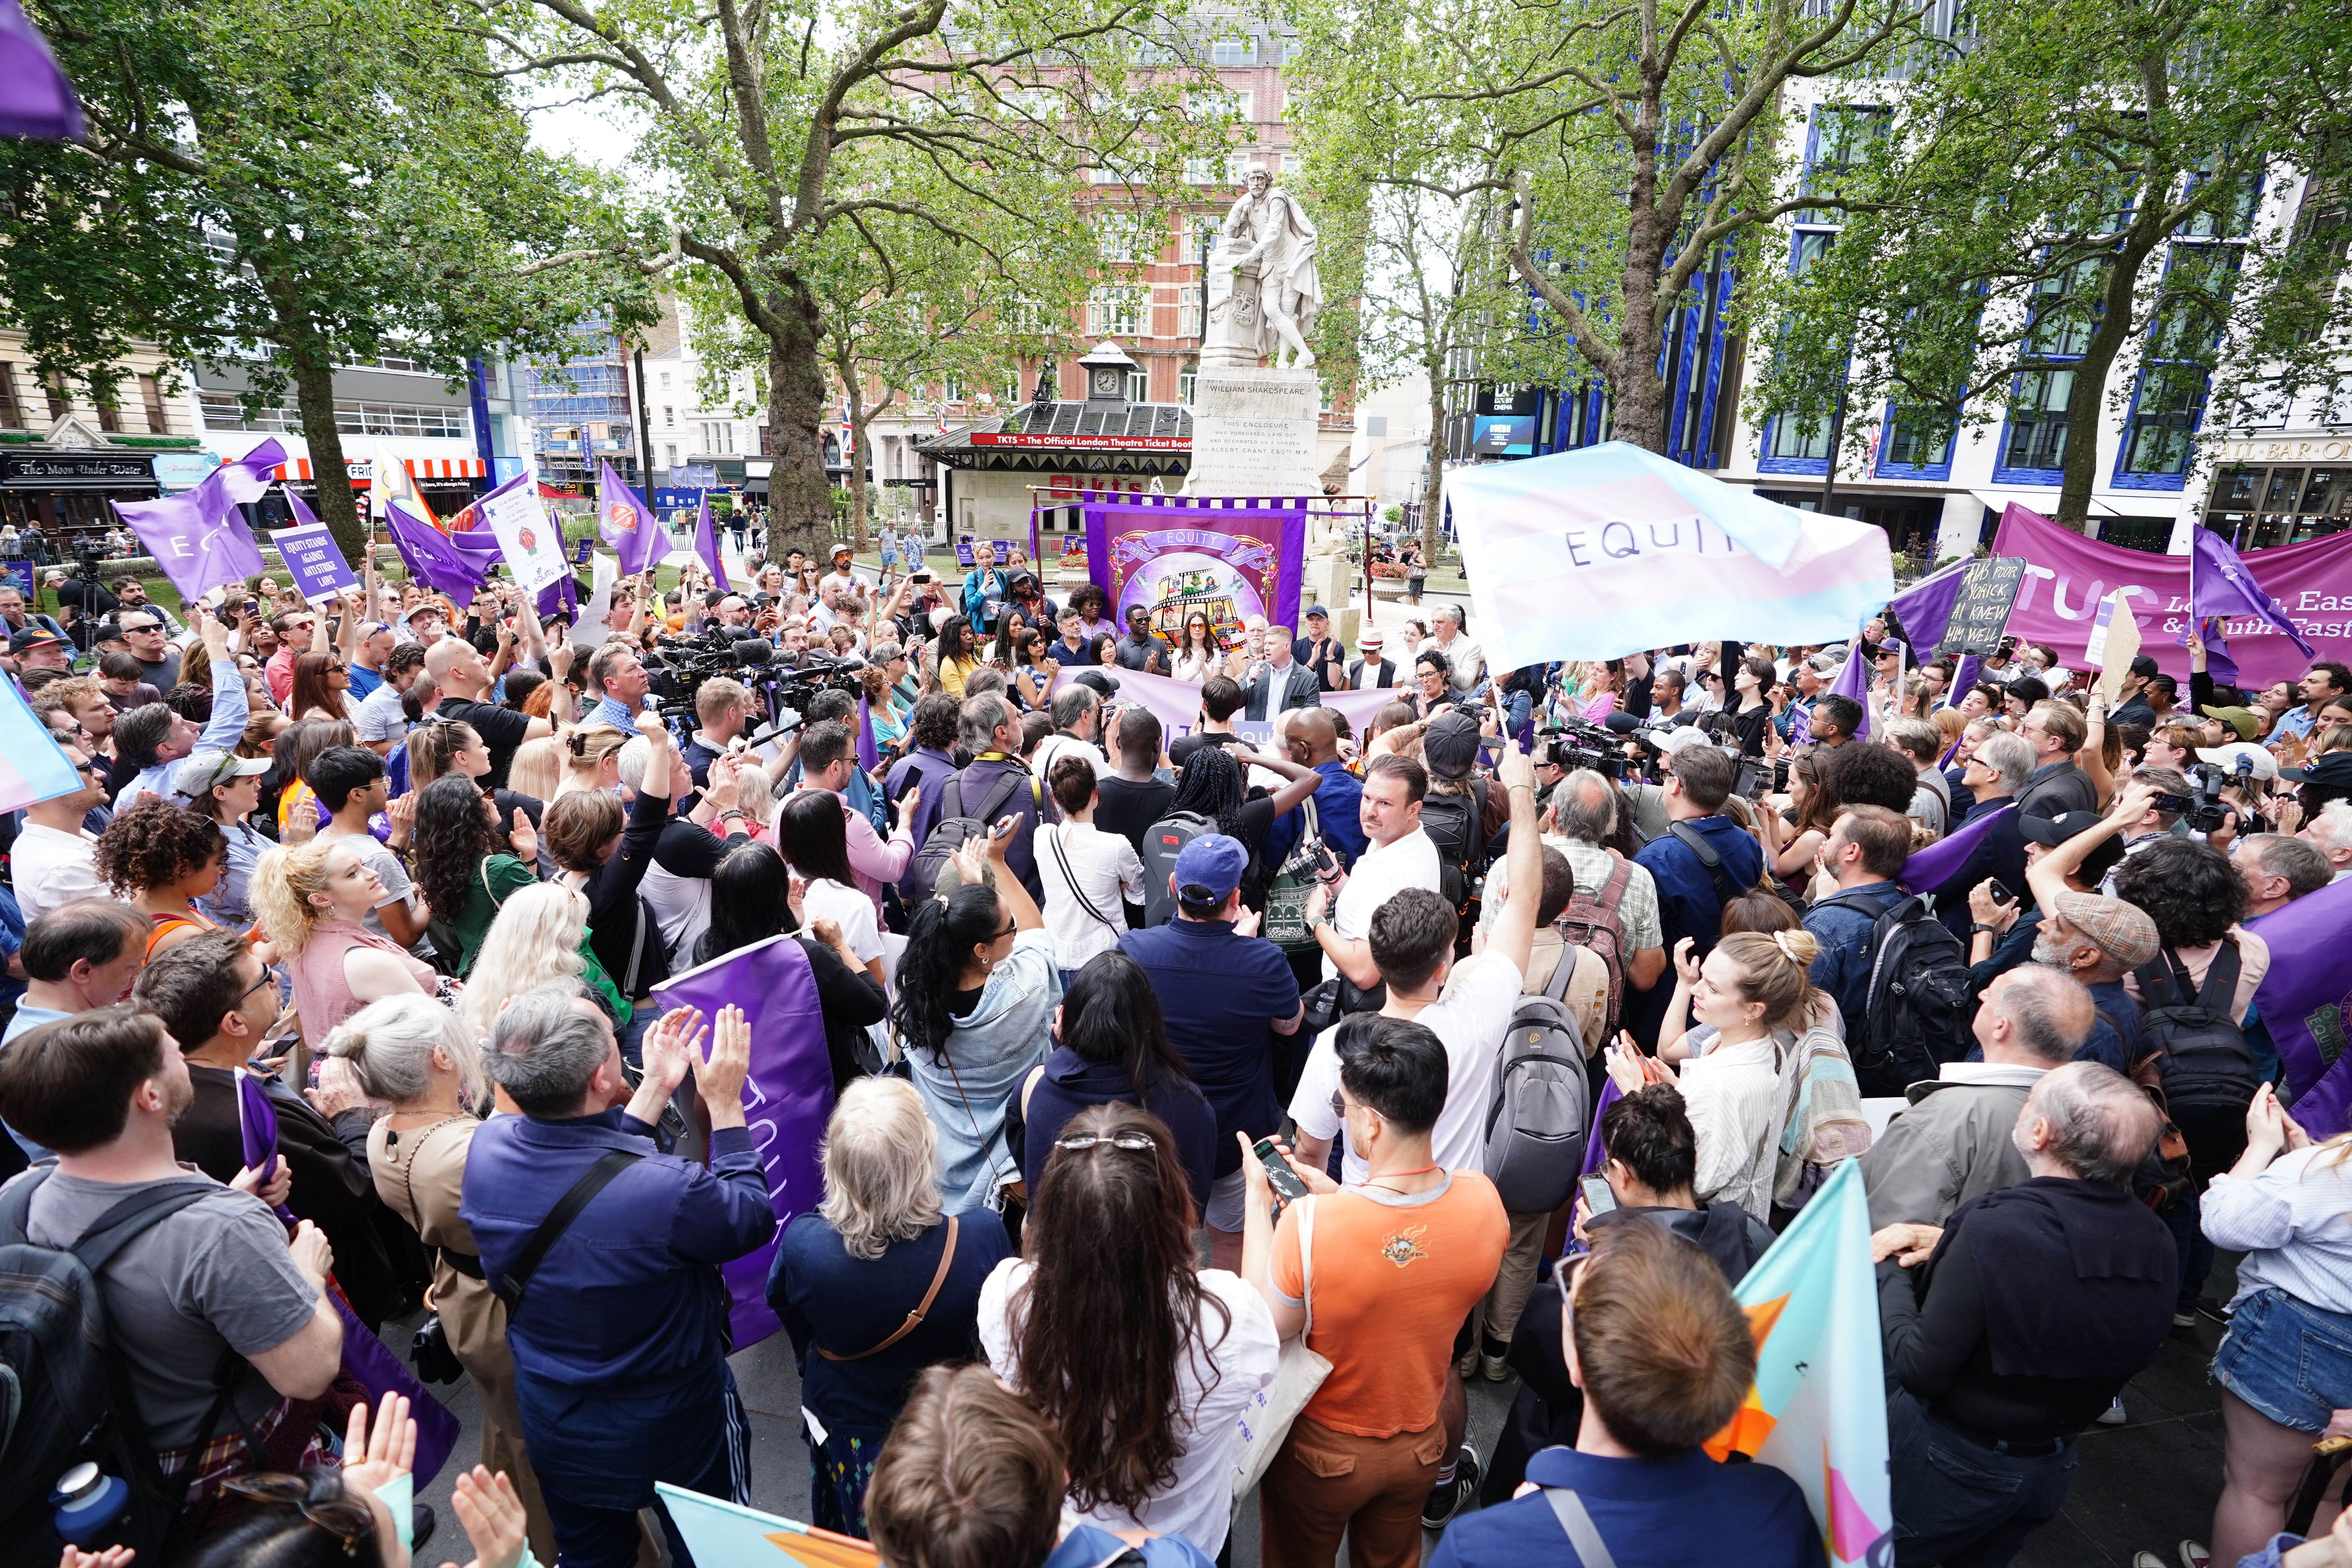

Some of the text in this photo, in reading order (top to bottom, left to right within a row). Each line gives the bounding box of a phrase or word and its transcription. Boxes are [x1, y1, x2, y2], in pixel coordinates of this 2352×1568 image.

[1248, 387, 1305, 395] SHAKESPEARE
[1490, 424, 1511, 433] ODEON
[1027, 436, 1042, 445] The
[1044, 437, 1075, 445] Official
[1077, 437, 1109, 446] London
[1111, 438, 1143, 447] Theatre
[1144, 439, 1170, 448] Ticket
[2215, 442, 2256, 459] ALL
[2266, 442, 2311, 459] BAR
[20, 460, 142, 475] The Moon Under Water
[1074, 476, 1143, 500] tkts
[284, 536, 328, 554] EQUITY STANDS
[1167, 532, 1218, 545] EQUITY
[300, 550, 326, 564] AGAINST
[1129, 545, 1144, 558] 1930
[317, 574, 336, 587] LAWS
[533, 568, 555, 584] equity
[1962, 563, 2018, 585] ALAS POOR
[1968, 583, 2009, 602] YORICK,
[1969, 604, 2011, 621] KNEW
[1944, 626, 1998, 642] HIM WELL
[2309, 1017, 2336, 1059] EQUITY
